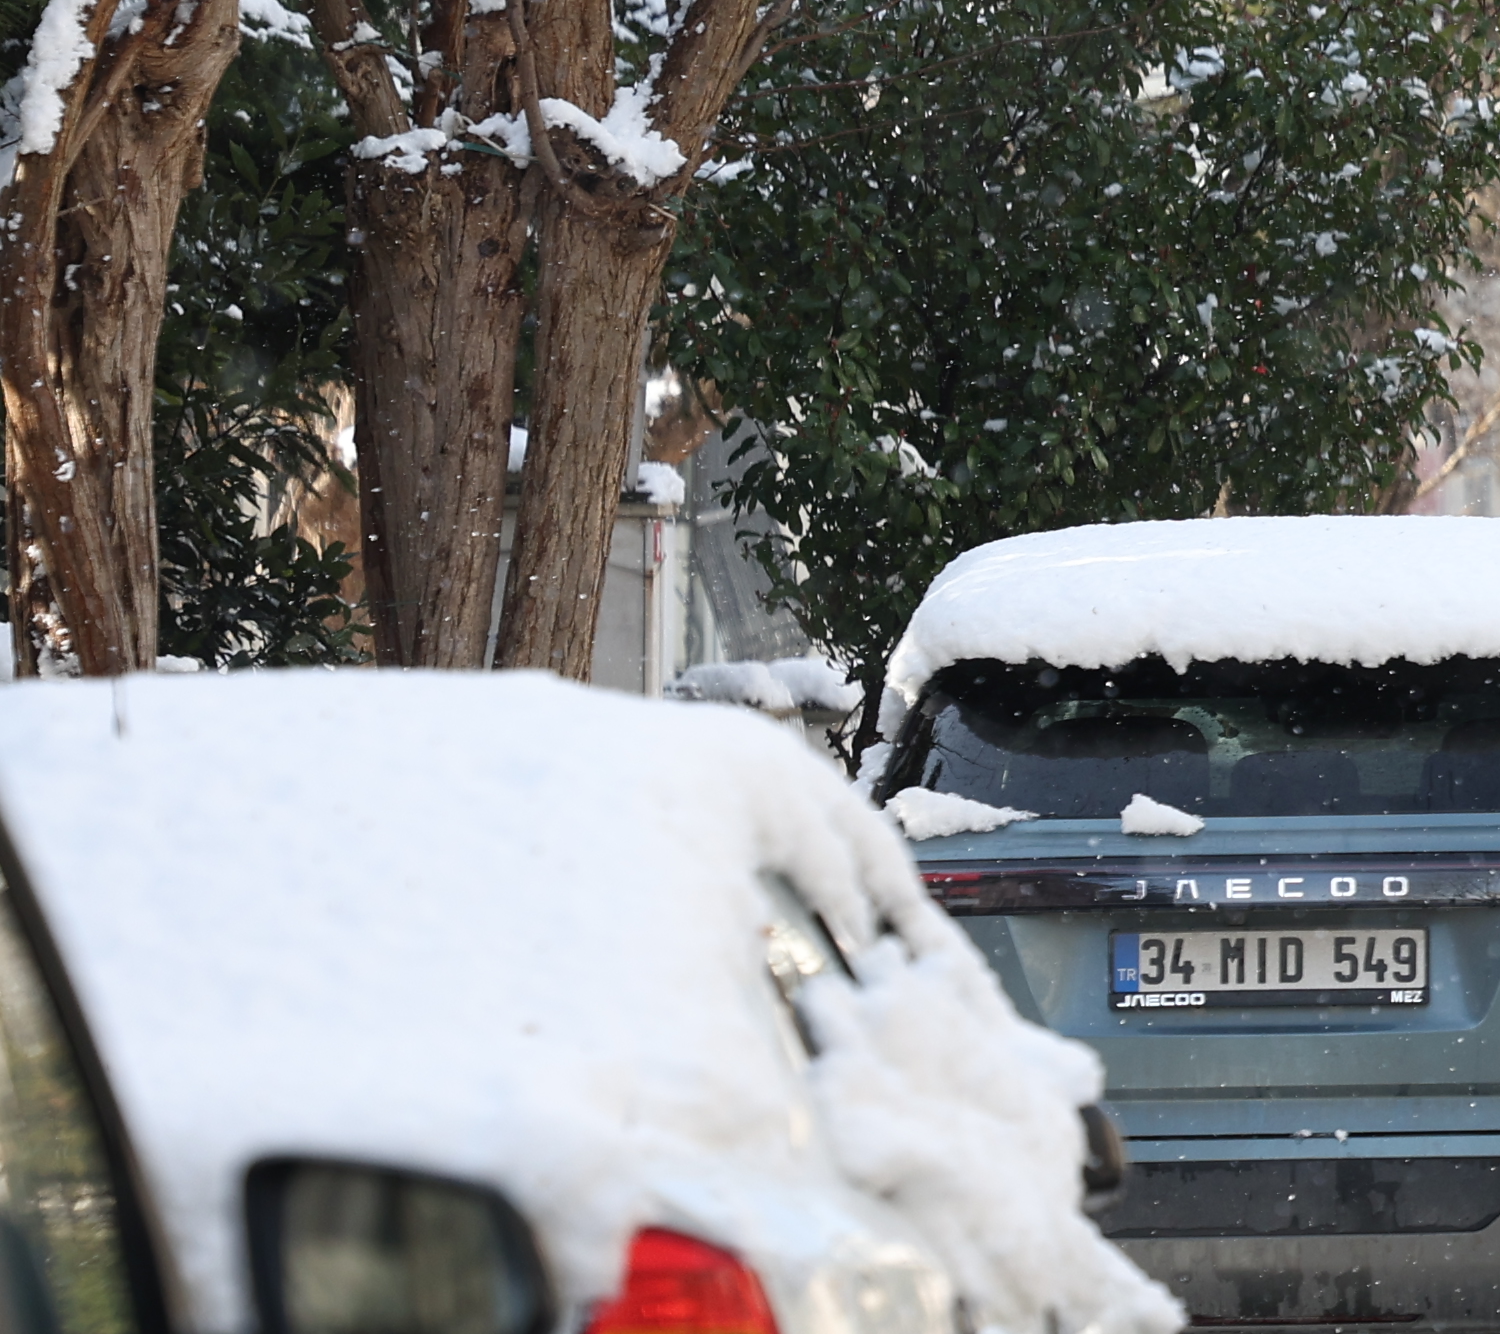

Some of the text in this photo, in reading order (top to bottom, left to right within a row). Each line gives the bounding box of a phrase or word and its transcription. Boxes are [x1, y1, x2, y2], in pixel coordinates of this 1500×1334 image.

[1121, 876, 1410, 900] JAECOO
[1140, 936, 1417, 985] 34 MID 549
[1116, 968, 1136, 981] TR
[1116, 993, 1206, 1008] JAECOO
